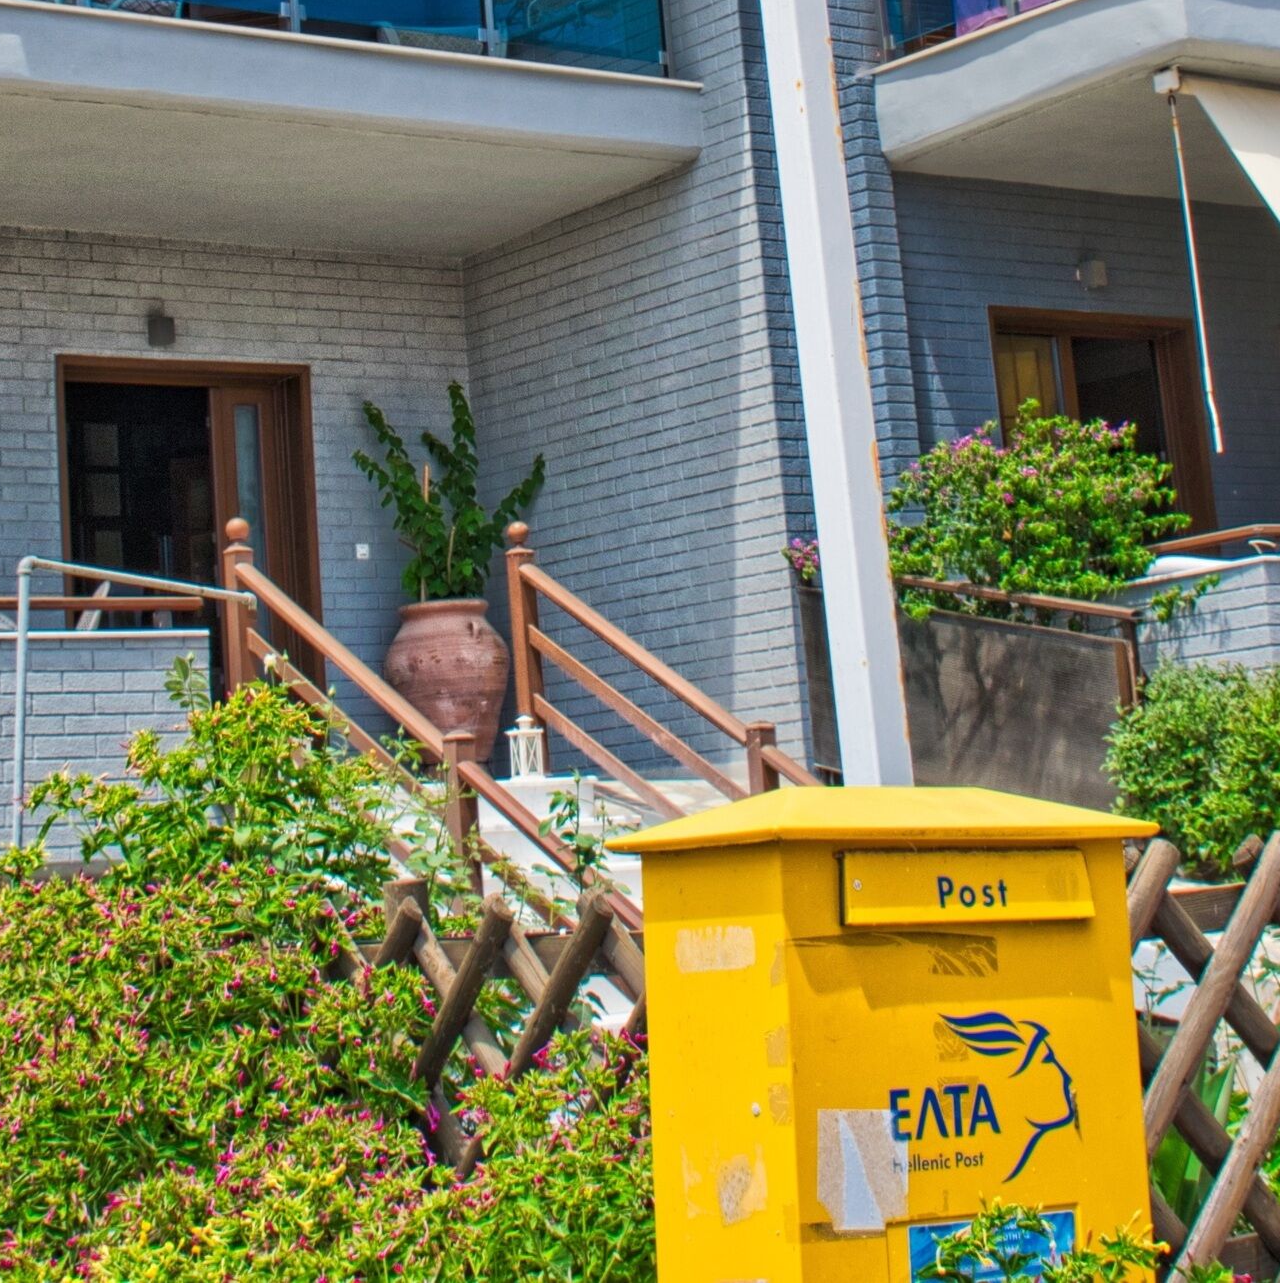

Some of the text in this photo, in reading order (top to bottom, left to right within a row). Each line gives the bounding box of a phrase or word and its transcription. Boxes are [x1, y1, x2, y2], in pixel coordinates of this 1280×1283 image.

[937, 875, 1007, 909] Post
[888, 1083, 1001, 1141] ΕΛΤΑ
[955, 1150, 984, 1168] Post
